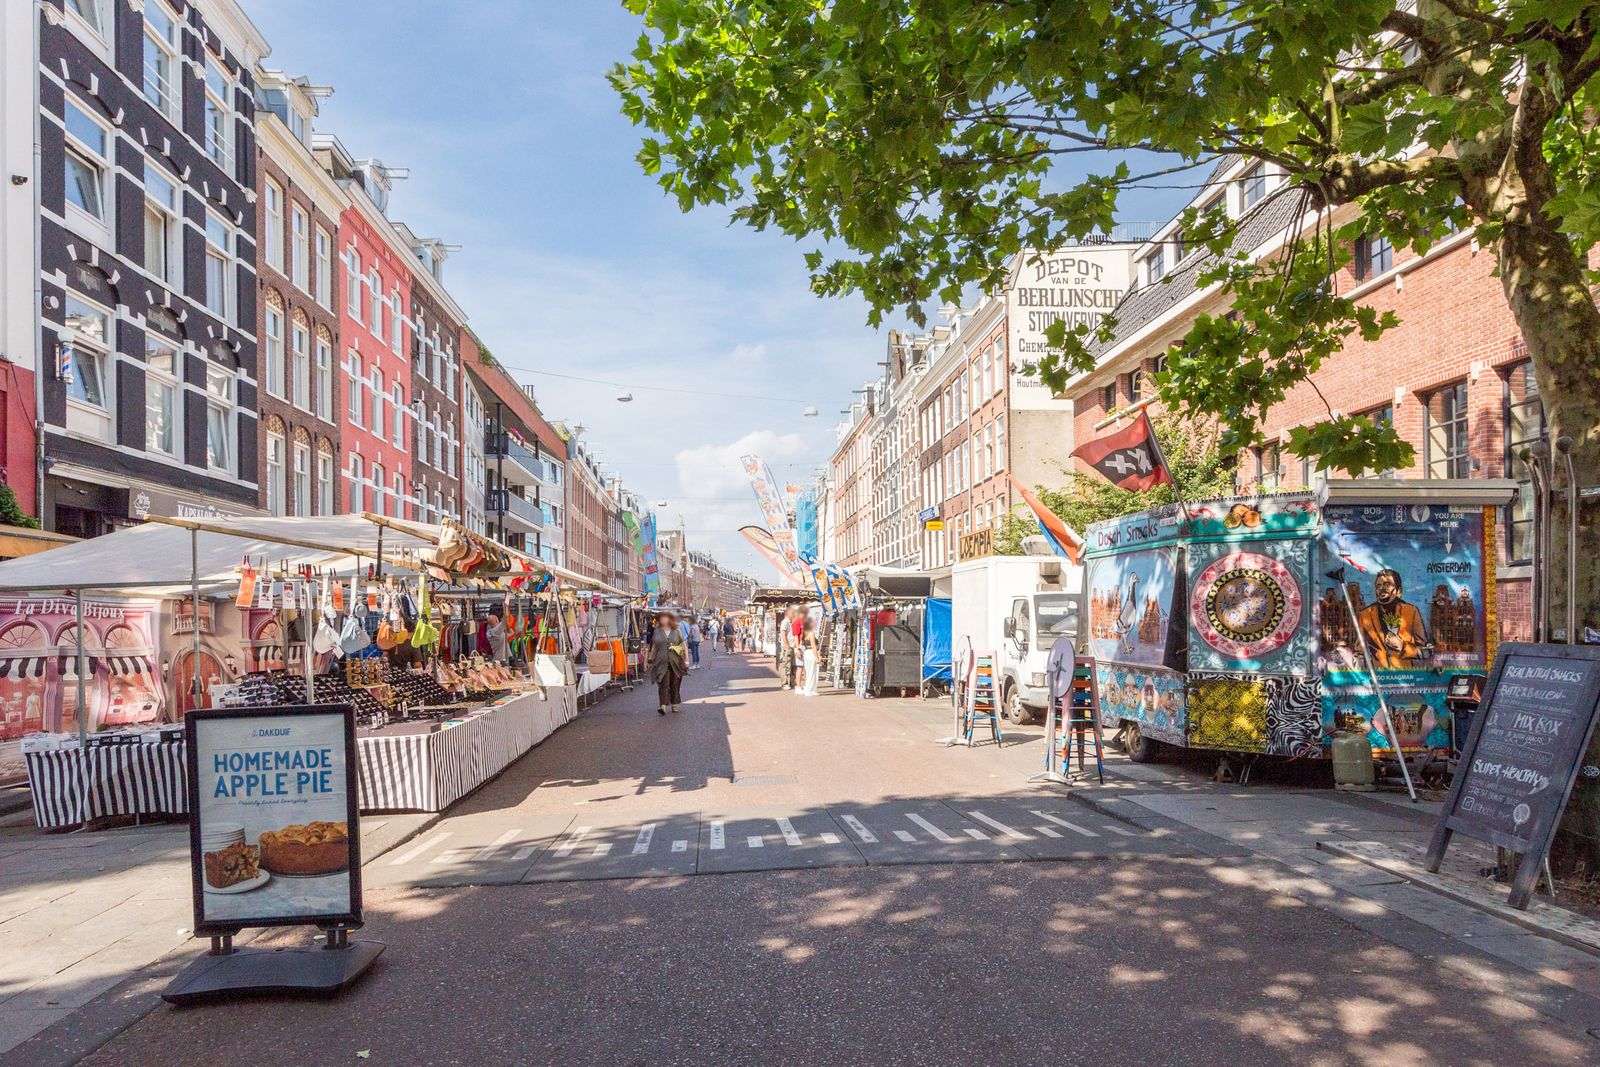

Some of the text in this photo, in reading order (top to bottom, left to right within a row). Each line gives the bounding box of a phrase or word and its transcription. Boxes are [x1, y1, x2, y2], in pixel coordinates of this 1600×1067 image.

[1035, 258, 1103, 282] DEPOT
[1051, 276, 1087, 285] VAN DE
[1017, 287, 1123, 308] BERLIJNSCHE
[1451, 512, 1465, 520] ARE
[1126, 520, 1159, 542] Snacks
[1426, 562, 1472, 573] AMSTERDAM
[40, 599, 78, 616] Diva
[83, 602, 125, 619] Bijoux
[259, 727, 292, 738] DAKDUIF
[213, 748, 332, 773] HOMEMADE
[213, 770, 333, 798] APPLE PIE
